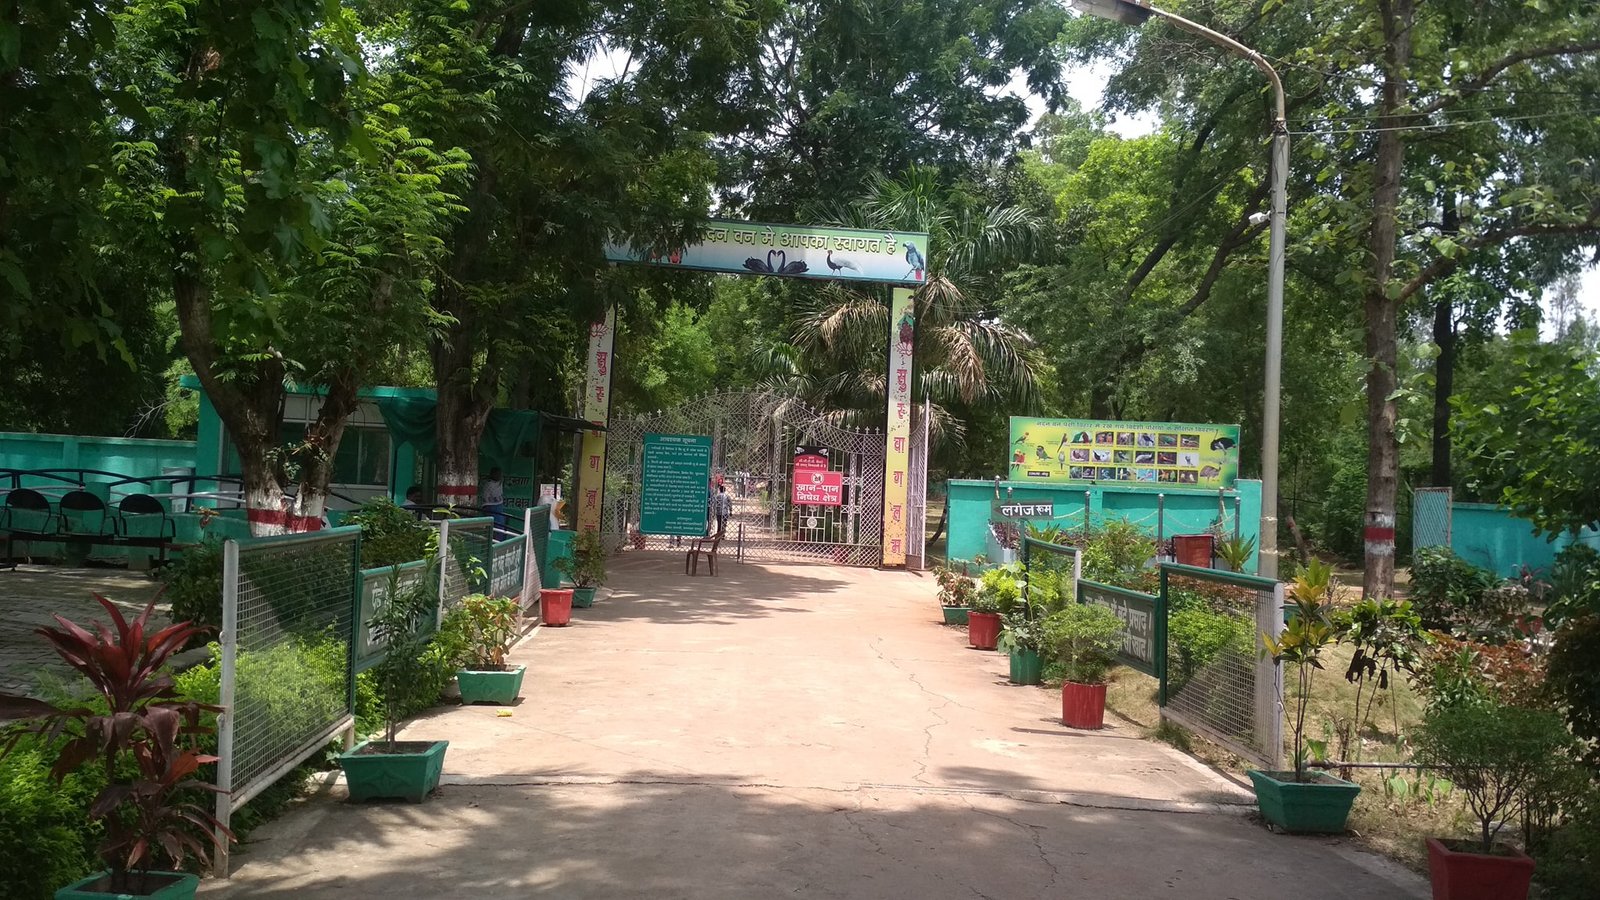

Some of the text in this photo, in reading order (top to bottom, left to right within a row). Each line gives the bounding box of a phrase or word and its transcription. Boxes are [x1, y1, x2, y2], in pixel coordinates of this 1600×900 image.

[733, 229, 757, 245] वन
[780, 231, 829, 250] आपका
[832, 235, 882, 253] स्वागत
[884, 232, 898, 255] है
[796, 484, 839, 492] खान-पान
[797, 491, 838, 503] निषेध क्षेत्र
[1000, 502, 1035, 516] लगेज
